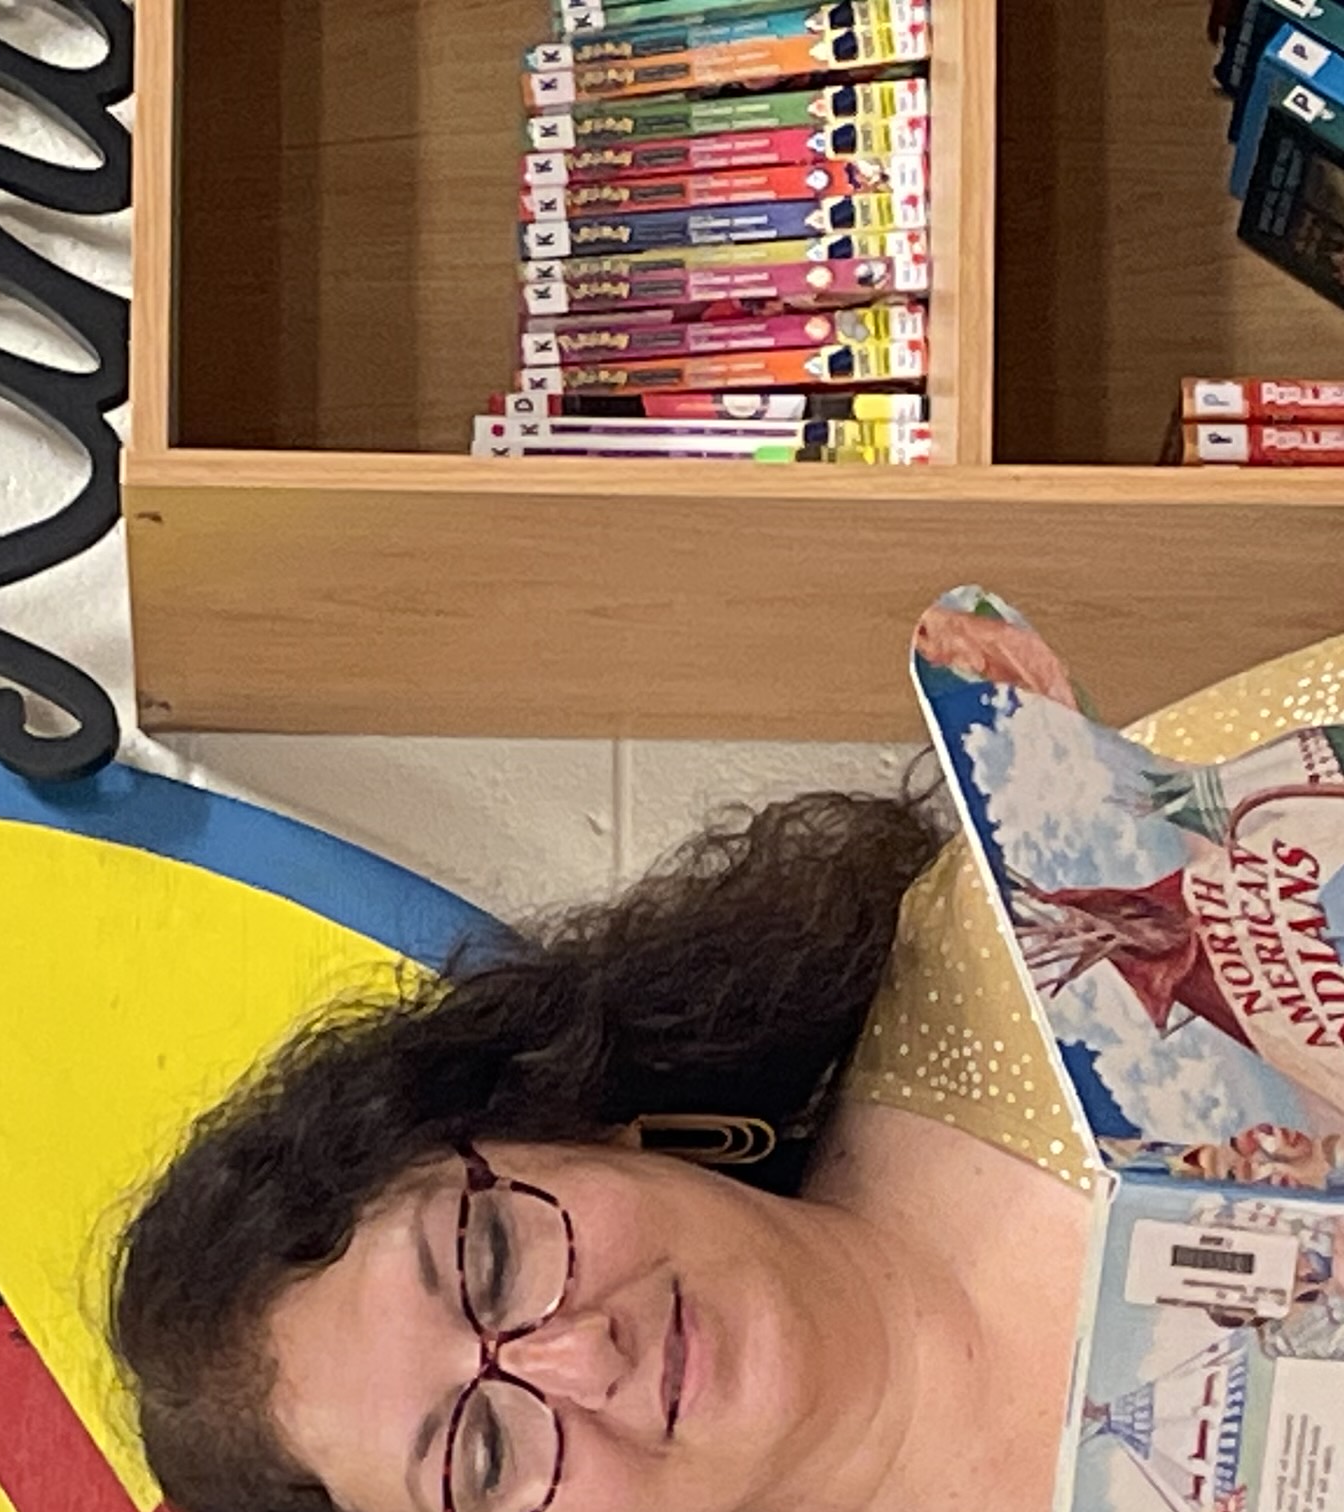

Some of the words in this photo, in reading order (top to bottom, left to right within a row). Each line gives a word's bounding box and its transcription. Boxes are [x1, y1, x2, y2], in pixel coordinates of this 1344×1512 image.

[574, 13, 592, 28] K
[542, 50, 560, 62] K
[540, 78, 557, 91] K
[541, 123, 559, 138] K
[534, 160, 552, 173] K
[540, 199, 557, 211] K
[536, 232, 554, 246] K
[537, 266, 554, 278] K
[533, 287, 551, 299] K
[534, 340, 552, 353] K
[530, 378, 546, 390] K
[515, 399, 533, 413] D
[521, 424, 538, 436] K
[1190, 874, 1274, 1018] NORTH
[1228, 845, 1339, 1050] AMERICAN
